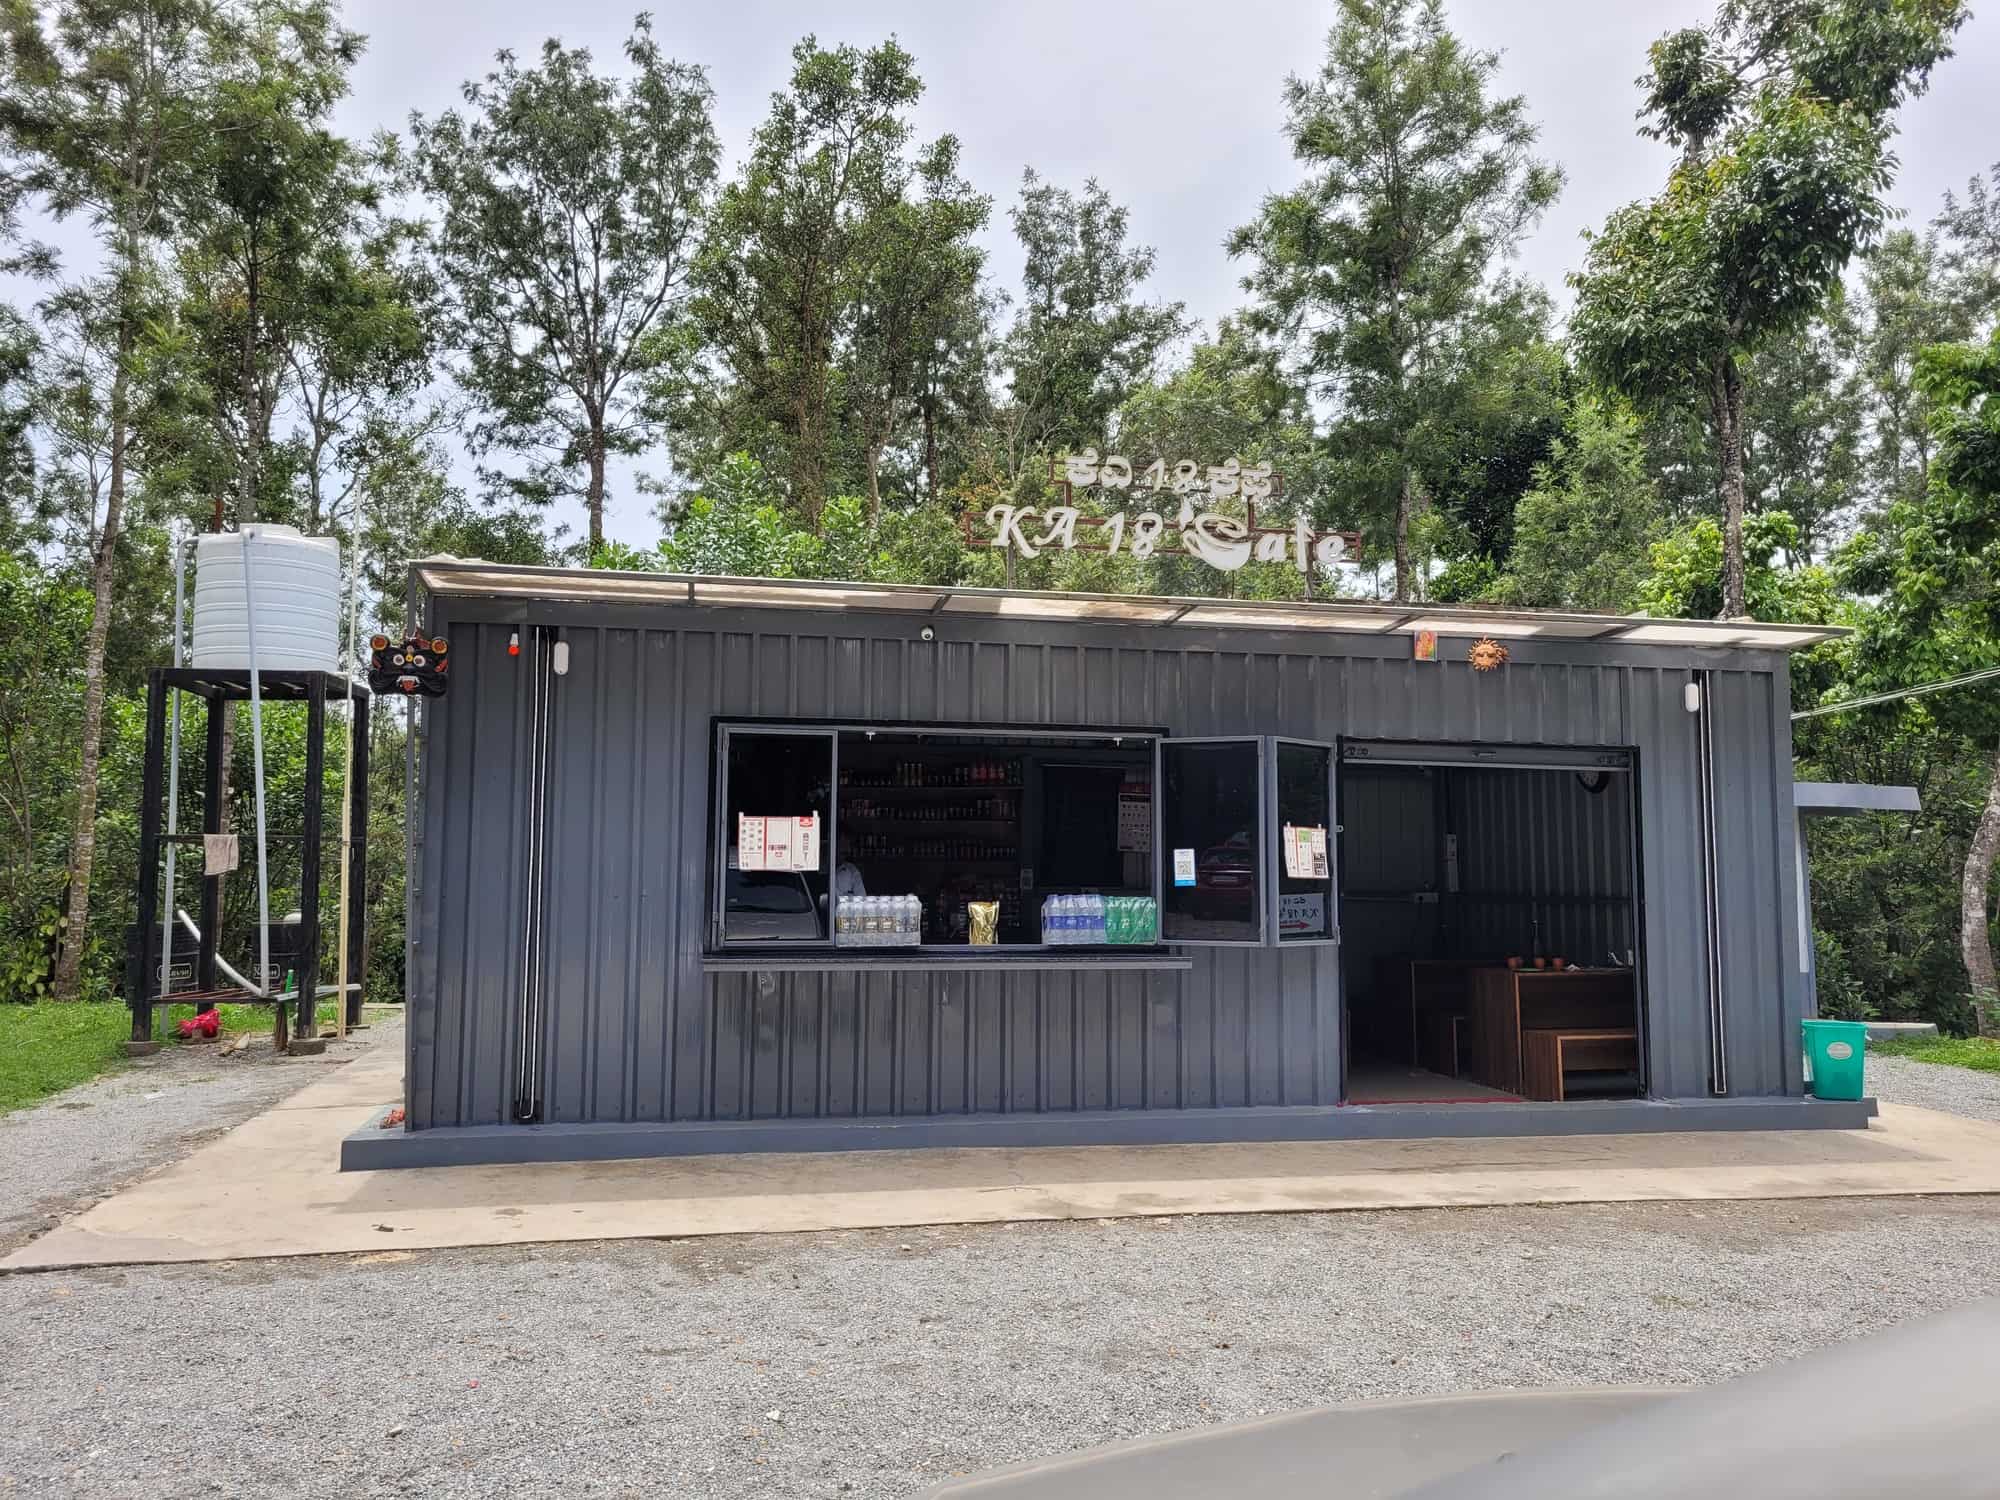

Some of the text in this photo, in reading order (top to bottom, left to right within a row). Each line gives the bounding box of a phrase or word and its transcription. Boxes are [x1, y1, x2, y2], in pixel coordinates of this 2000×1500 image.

[1143, 457, 1197, 495] 18
[985, 504, 1079, 559] KA
[1101, 511, 1163, 558] 18
